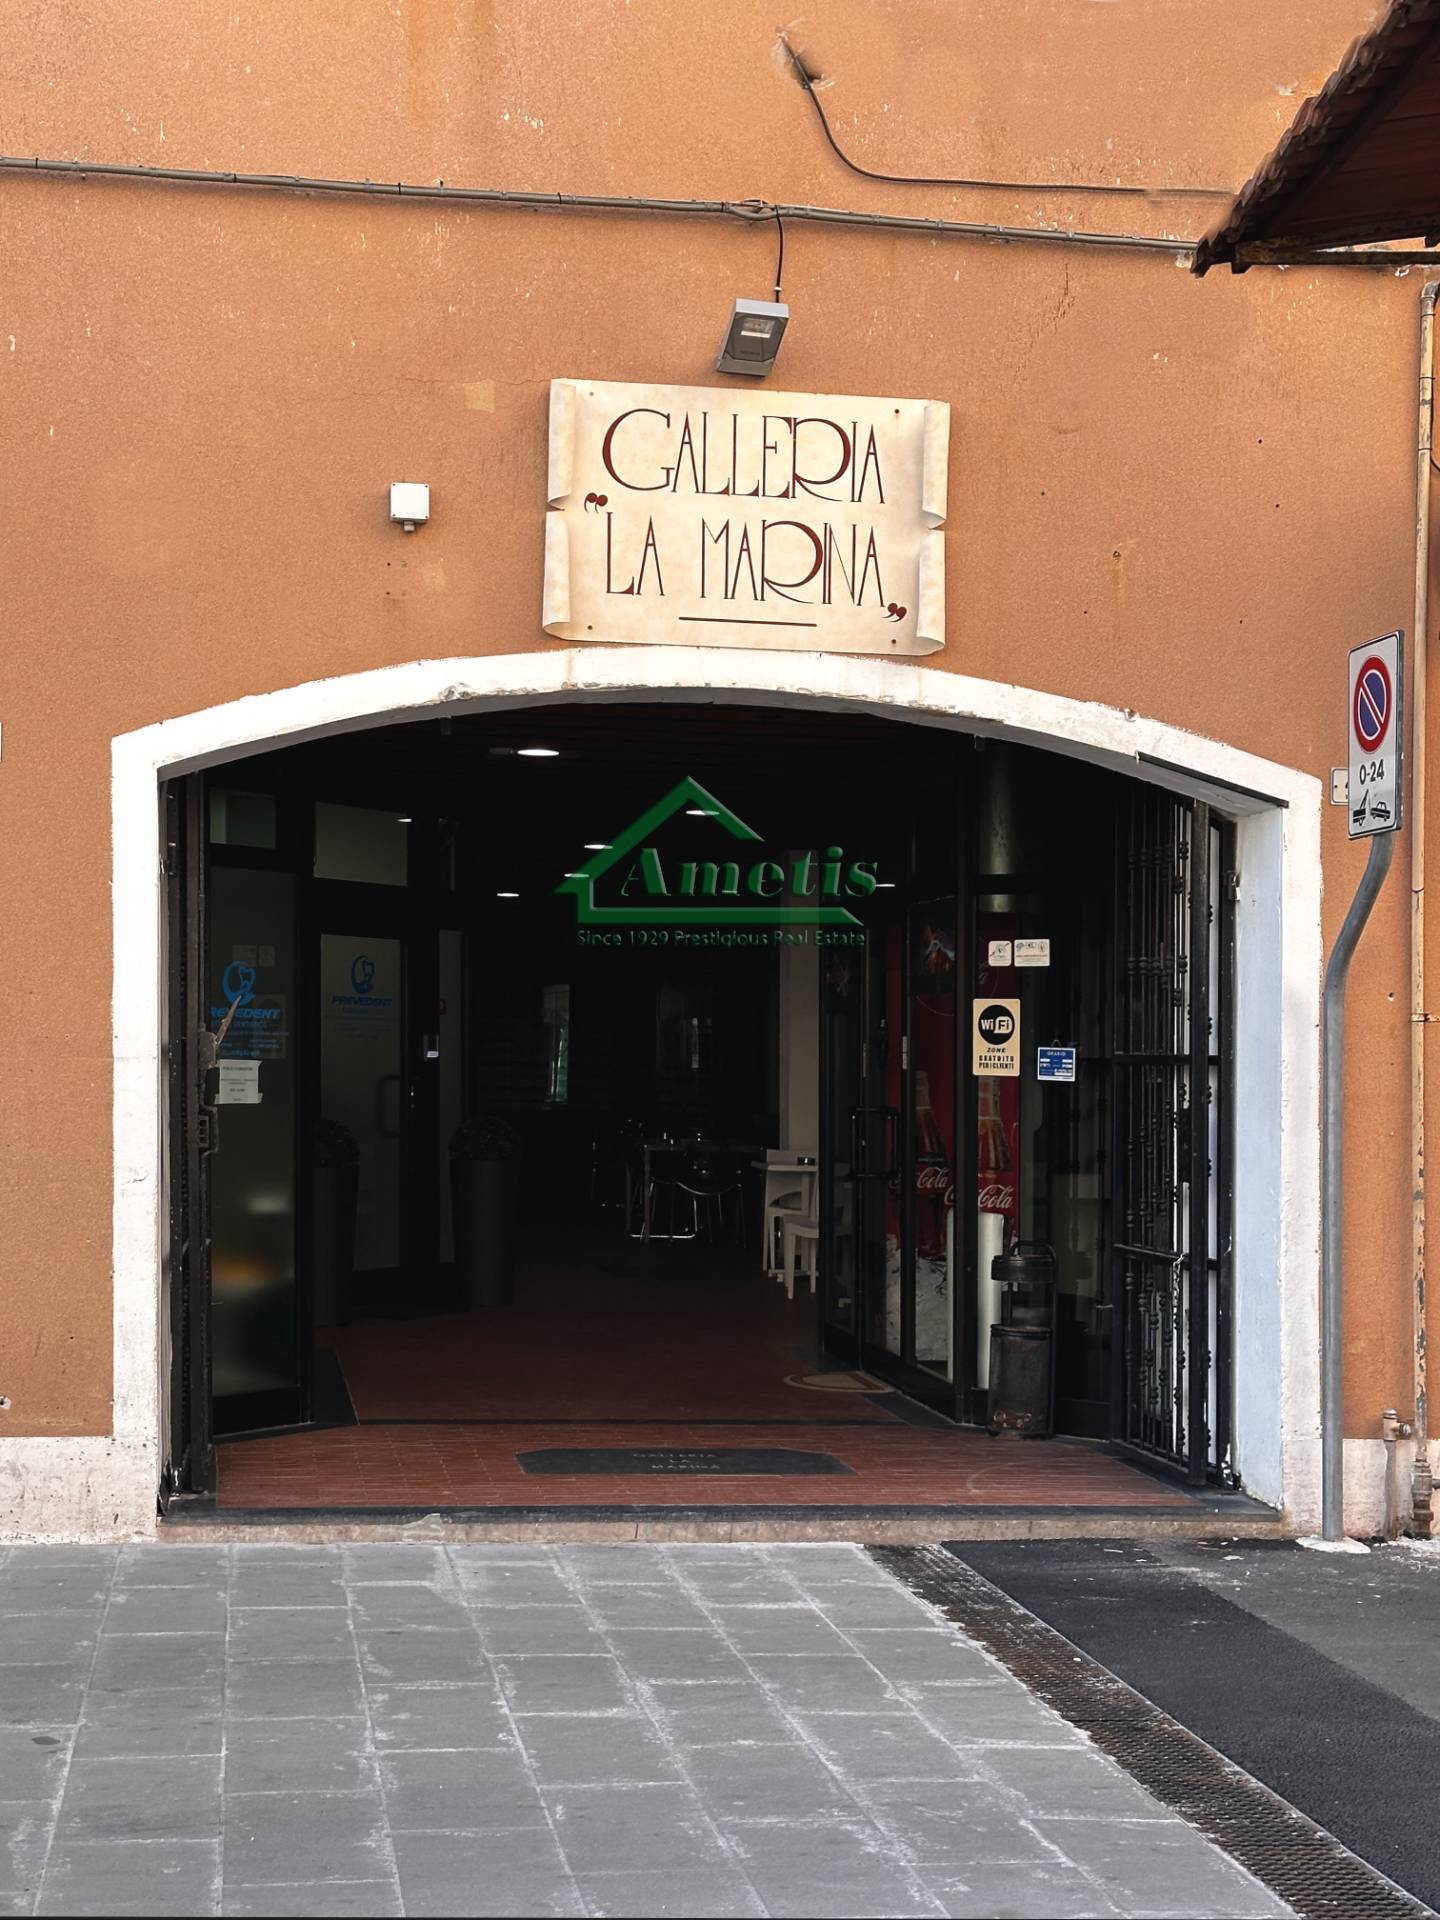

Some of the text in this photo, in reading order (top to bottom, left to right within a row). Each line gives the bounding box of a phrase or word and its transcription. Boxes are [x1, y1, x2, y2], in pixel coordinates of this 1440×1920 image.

[602, 408, 886, 504] GALLERIA
[1359, 758, 1385, 785] 0-24
[917, 1167, 950, 1188] Cola
[977, 1184, 1014, 1208] Cola
